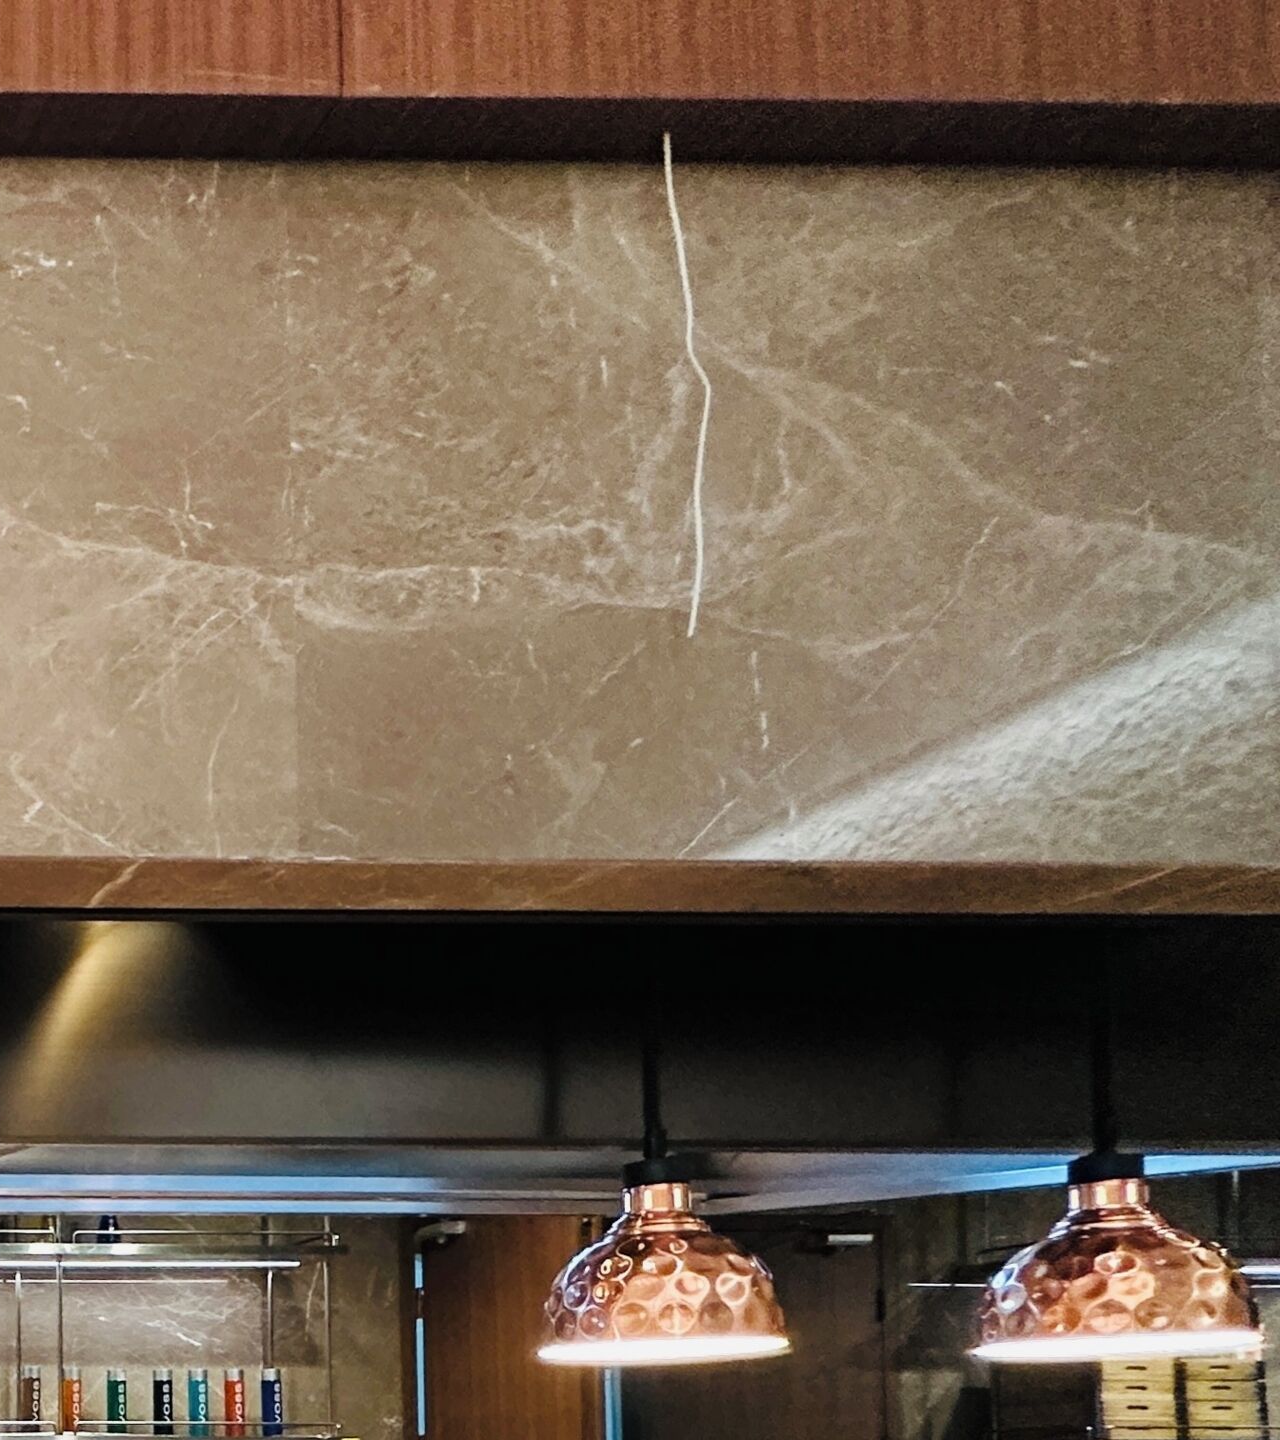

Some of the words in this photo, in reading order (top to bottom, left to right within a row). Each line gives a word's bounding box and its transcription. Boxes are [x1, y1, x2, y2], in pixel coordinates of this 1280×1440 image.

[32, 1381, 40, 1421] VOSS
[72, 1382, 80, 1425] VOSS
[118, 1384, 126, 1421] VOSS
[162, 1383, 170, 1421] VOSS
[198, 1383, 206, 1422] VOSS
[234, 1383, 243, 1422] VOSS
[273, 1383, 282, 1422] VOSS
